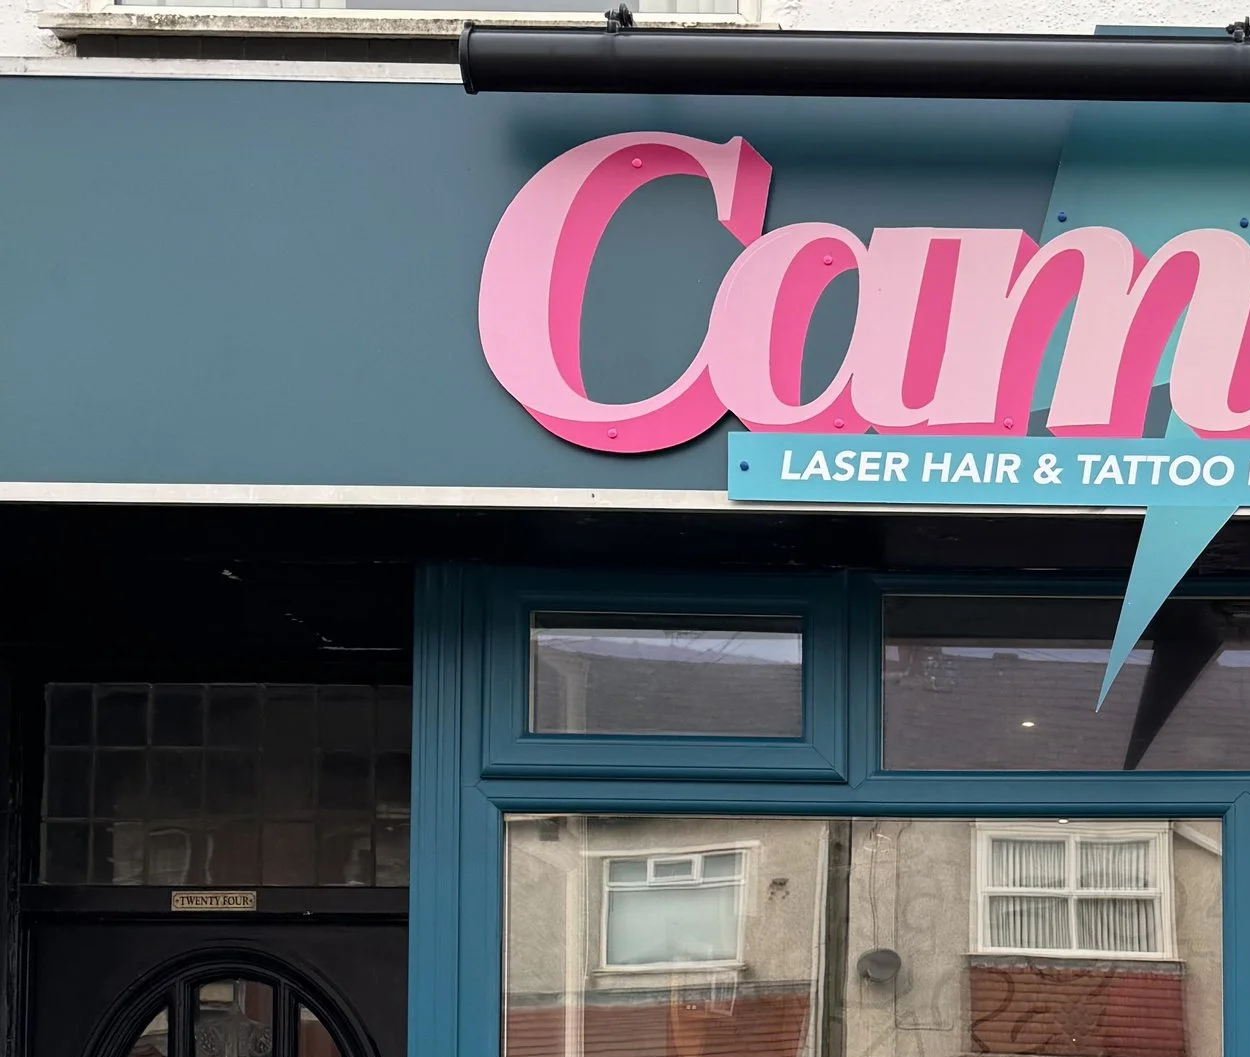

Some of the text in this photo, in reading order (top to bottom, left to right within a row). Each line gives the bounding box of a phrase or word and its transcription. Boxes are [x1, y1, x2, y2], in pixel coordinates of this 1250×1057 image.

[780, 450, 909, 482] LASER
[921, 452, 1021, 484] HAIR
[1033, 453, 1063, 484] &
[1077, 454, 1234, 485] TATTOO
[180, 896, 249, 905] TWENTY FOUR
